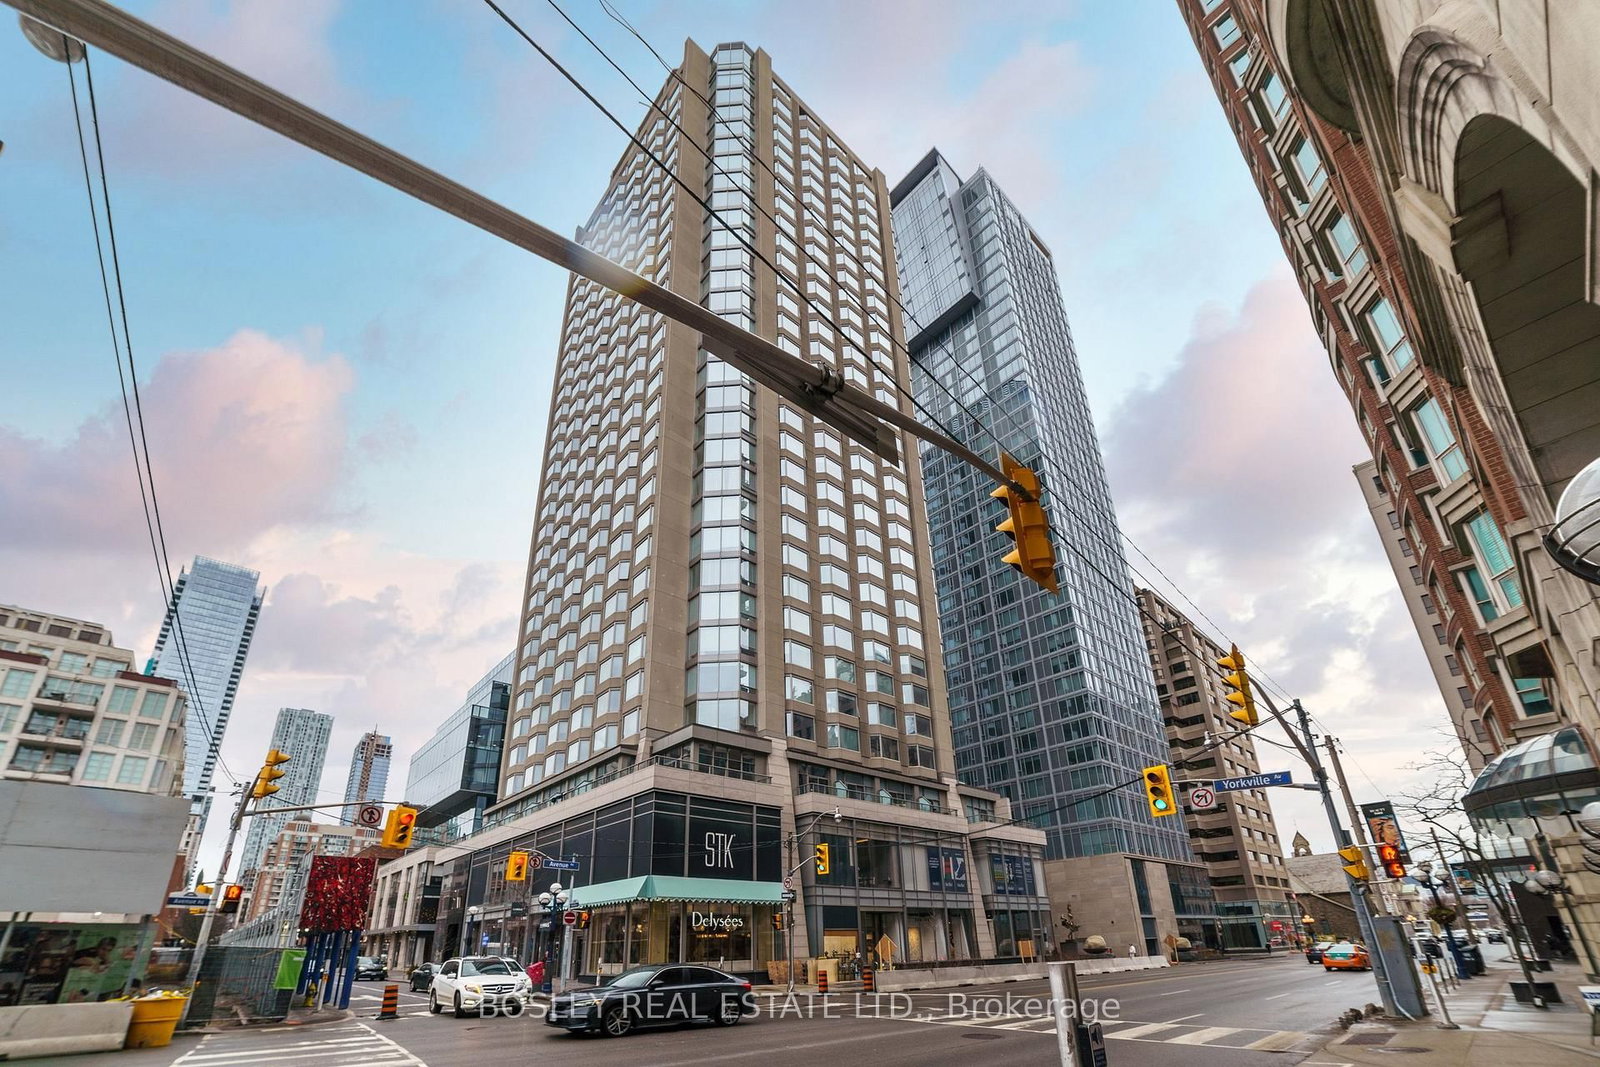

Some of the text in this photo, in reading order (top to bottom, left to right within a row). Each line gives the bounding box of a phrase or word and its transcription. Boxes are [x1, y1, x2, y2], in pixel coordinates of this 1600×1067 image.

[1222, 776, 1271, 789] Yorkville
[704, 831, 735, 869] STK
[691, 911, 744, 931] Delysées
